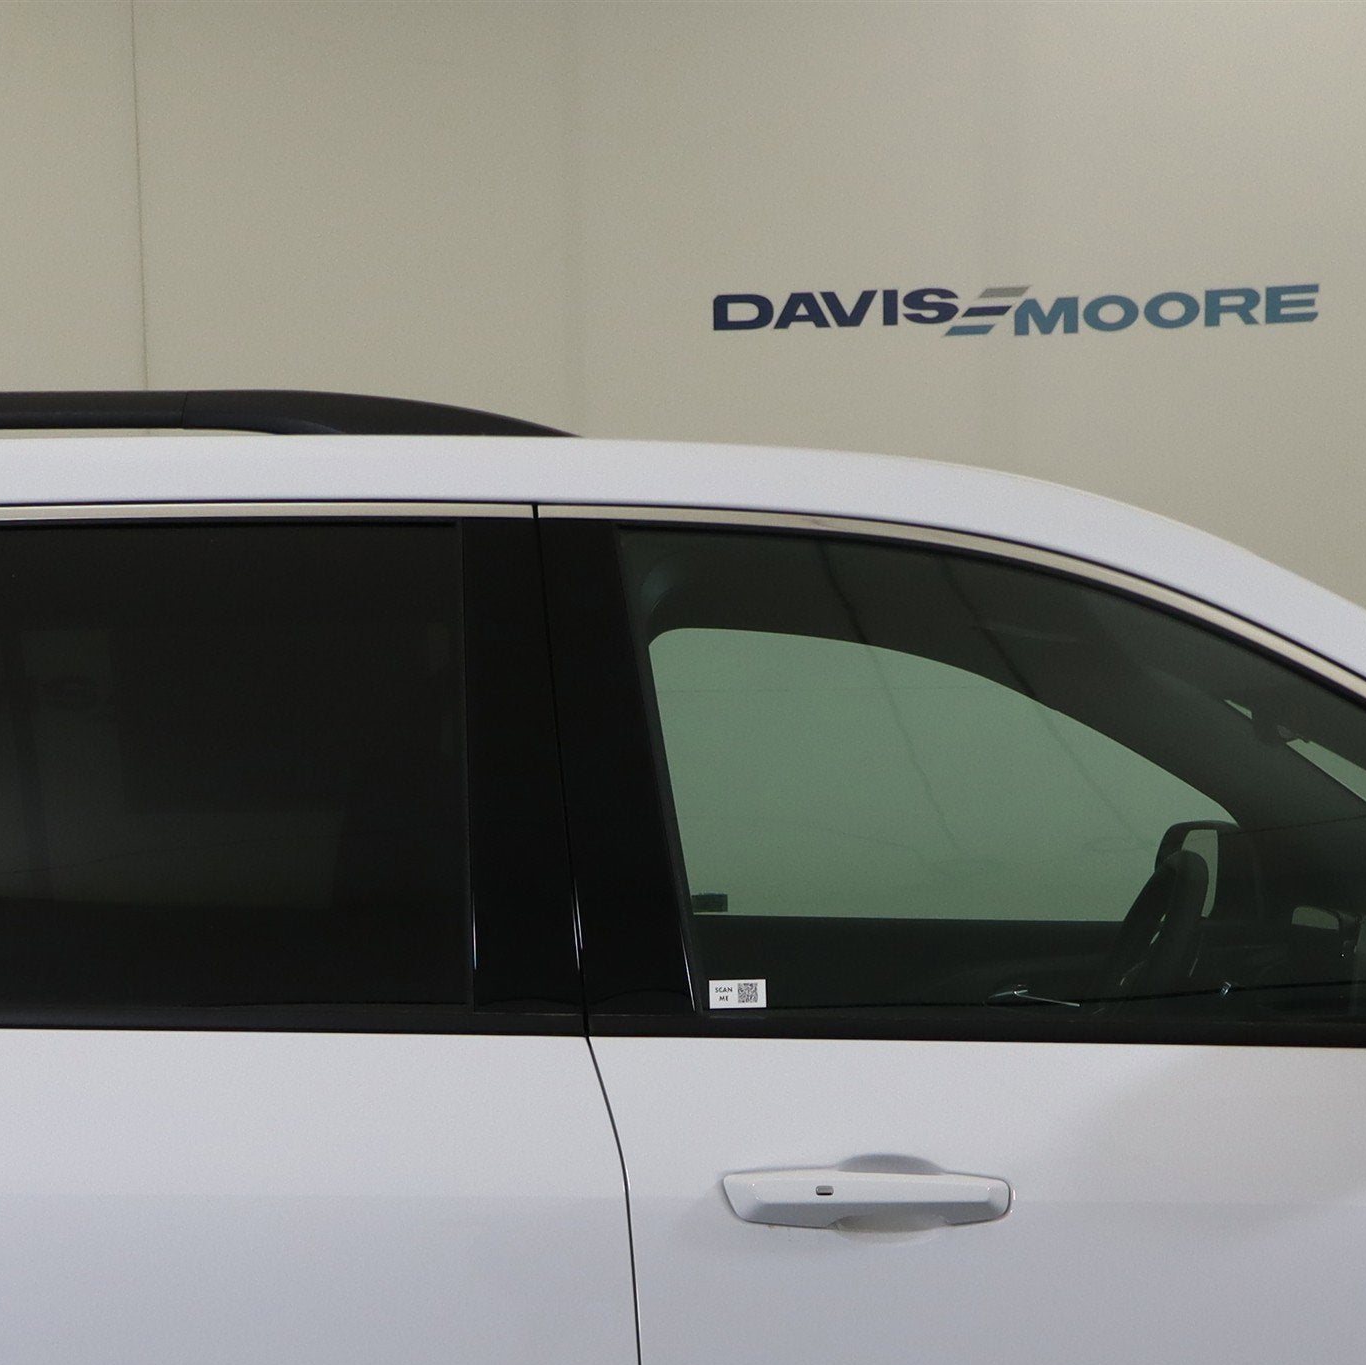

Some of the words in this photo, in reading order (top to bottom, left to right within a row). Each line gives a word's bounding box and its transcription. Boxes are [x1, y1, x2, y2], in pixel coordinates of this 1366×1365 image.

[713, 287, 960, 331] DAVIS
[1013, 284, 1320, 336] MOORE
[715, 986, 733, 994] SCAN
